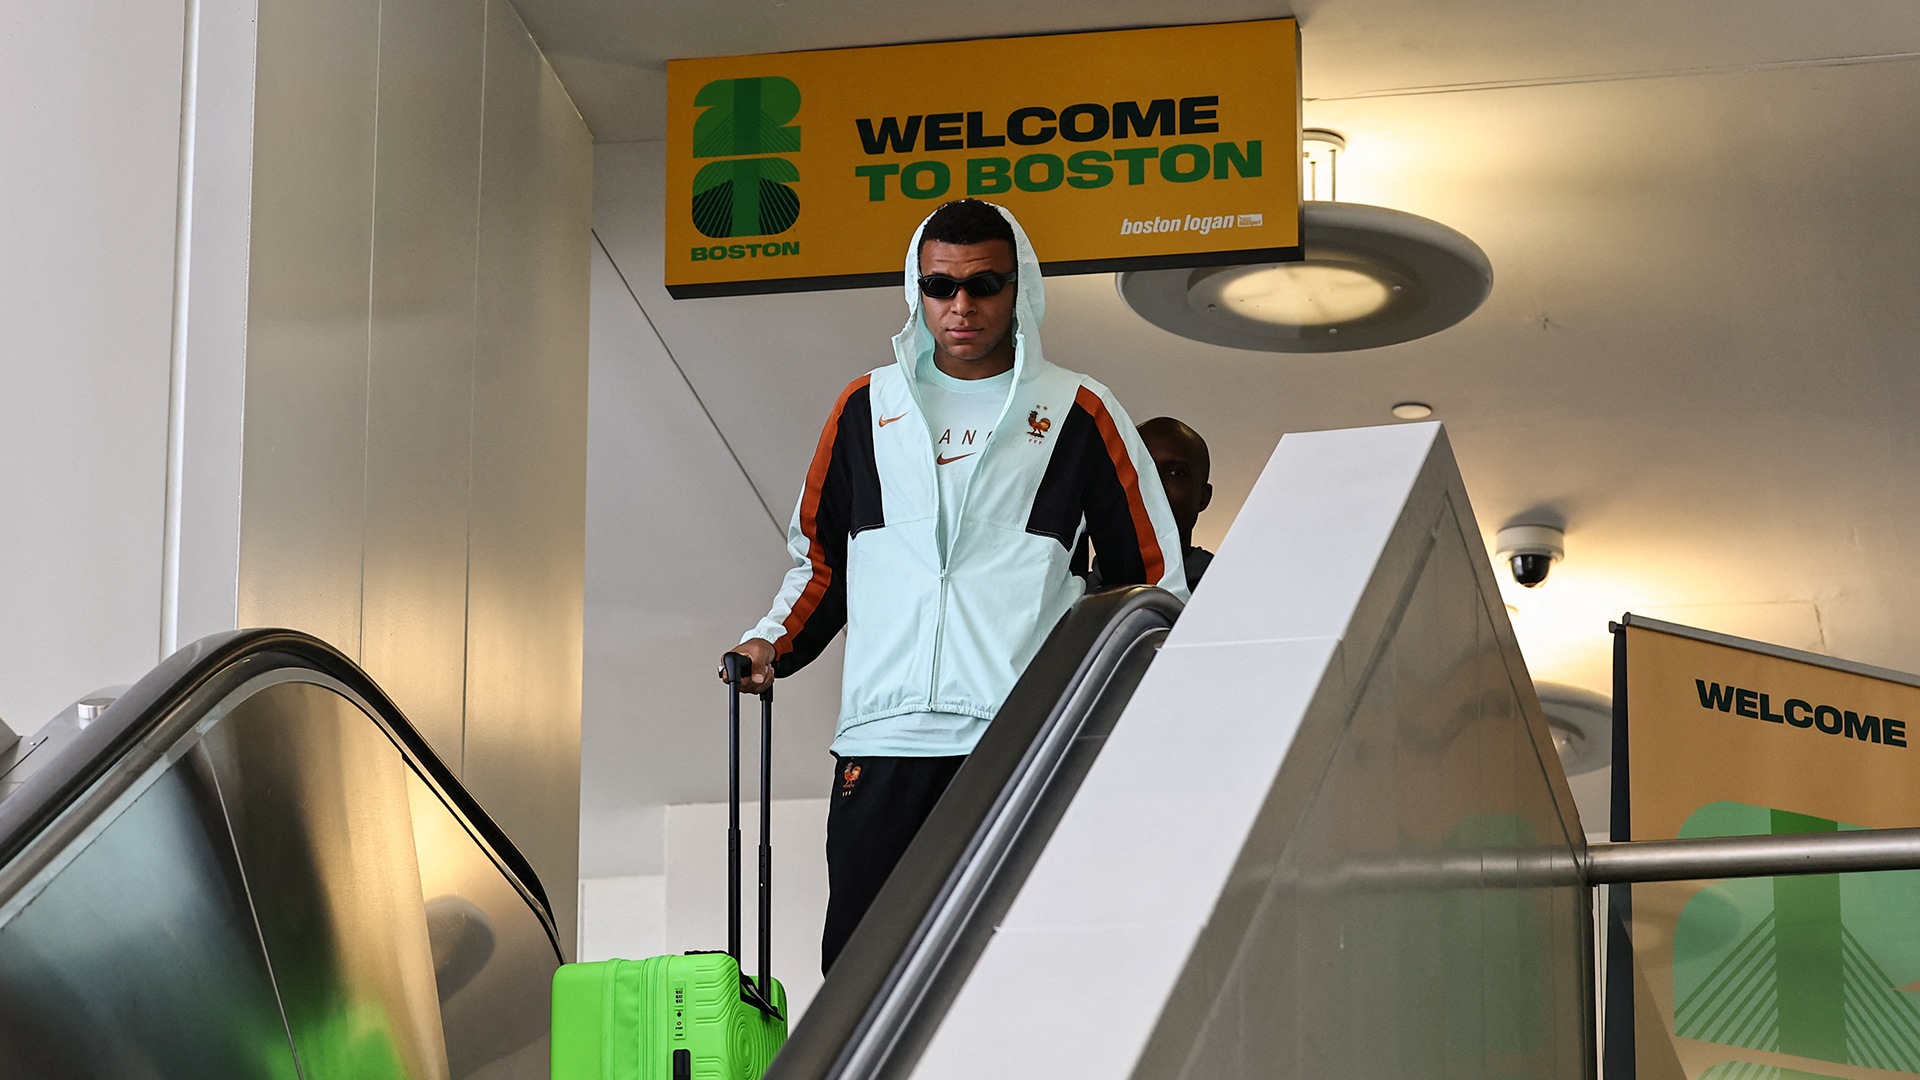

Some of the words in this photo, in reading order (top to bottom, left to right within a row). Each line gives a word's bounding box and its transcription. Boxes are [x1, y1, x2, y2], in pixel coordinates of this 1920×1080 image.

[855, 95, 1219, 155] WELCOME
[855, 160, 950, 202] TO
[966, 140, 1262, 196] BOSTON
[691, 241, 800, 261] BOSTON
[1120, 216, 1182, 235] boston
[1183, 214, 1235, 235] logan
[1695, 678, 1908, 748] WELCOME
